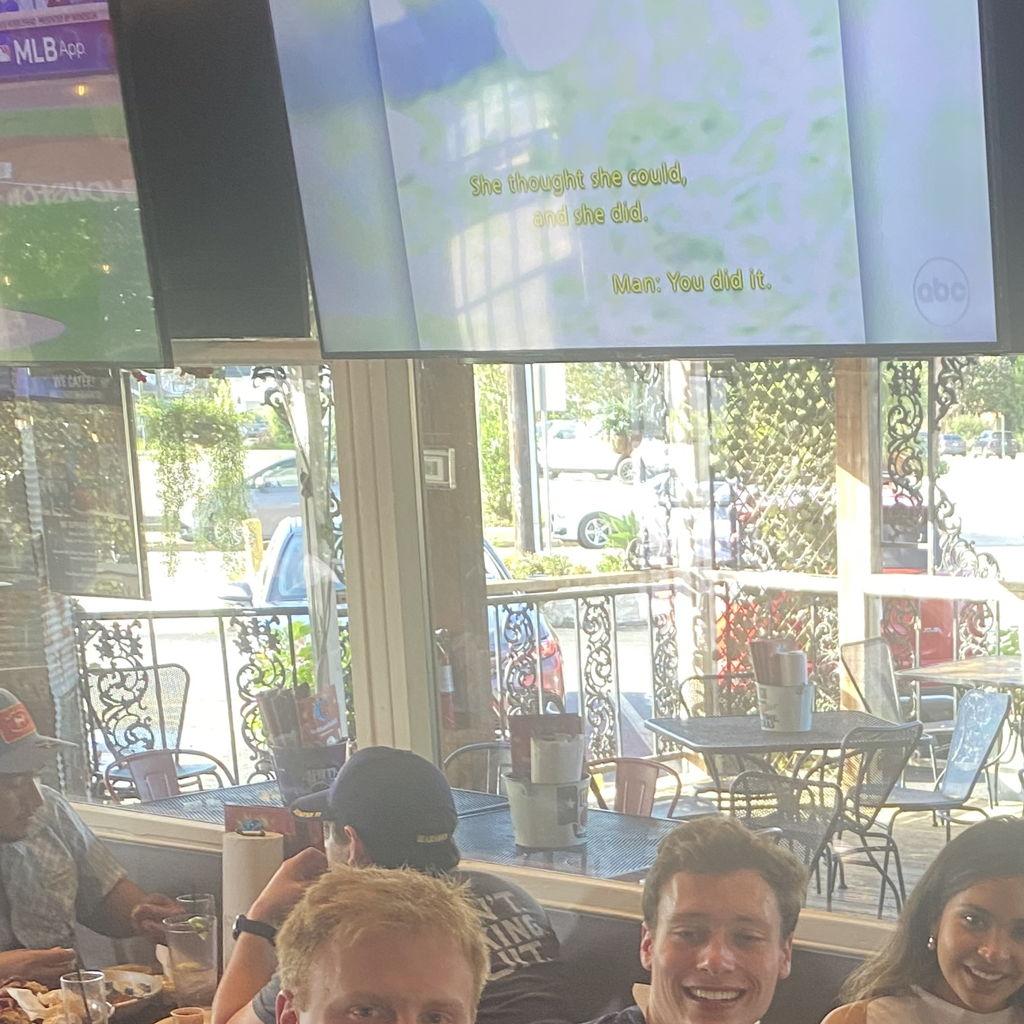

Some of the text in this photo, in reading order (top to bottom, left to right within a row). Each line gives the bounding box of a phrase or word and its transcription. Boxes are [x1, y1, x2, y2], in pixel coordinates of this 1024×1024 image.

[13, 36, 87, 65] MLB App
[470, 161, 688, 197] She thought she could,
[533, 201, 648, 227] and she did.
[611, 268, 772, 294] Man: You did it.
[917, 278, 967, 303] abc
